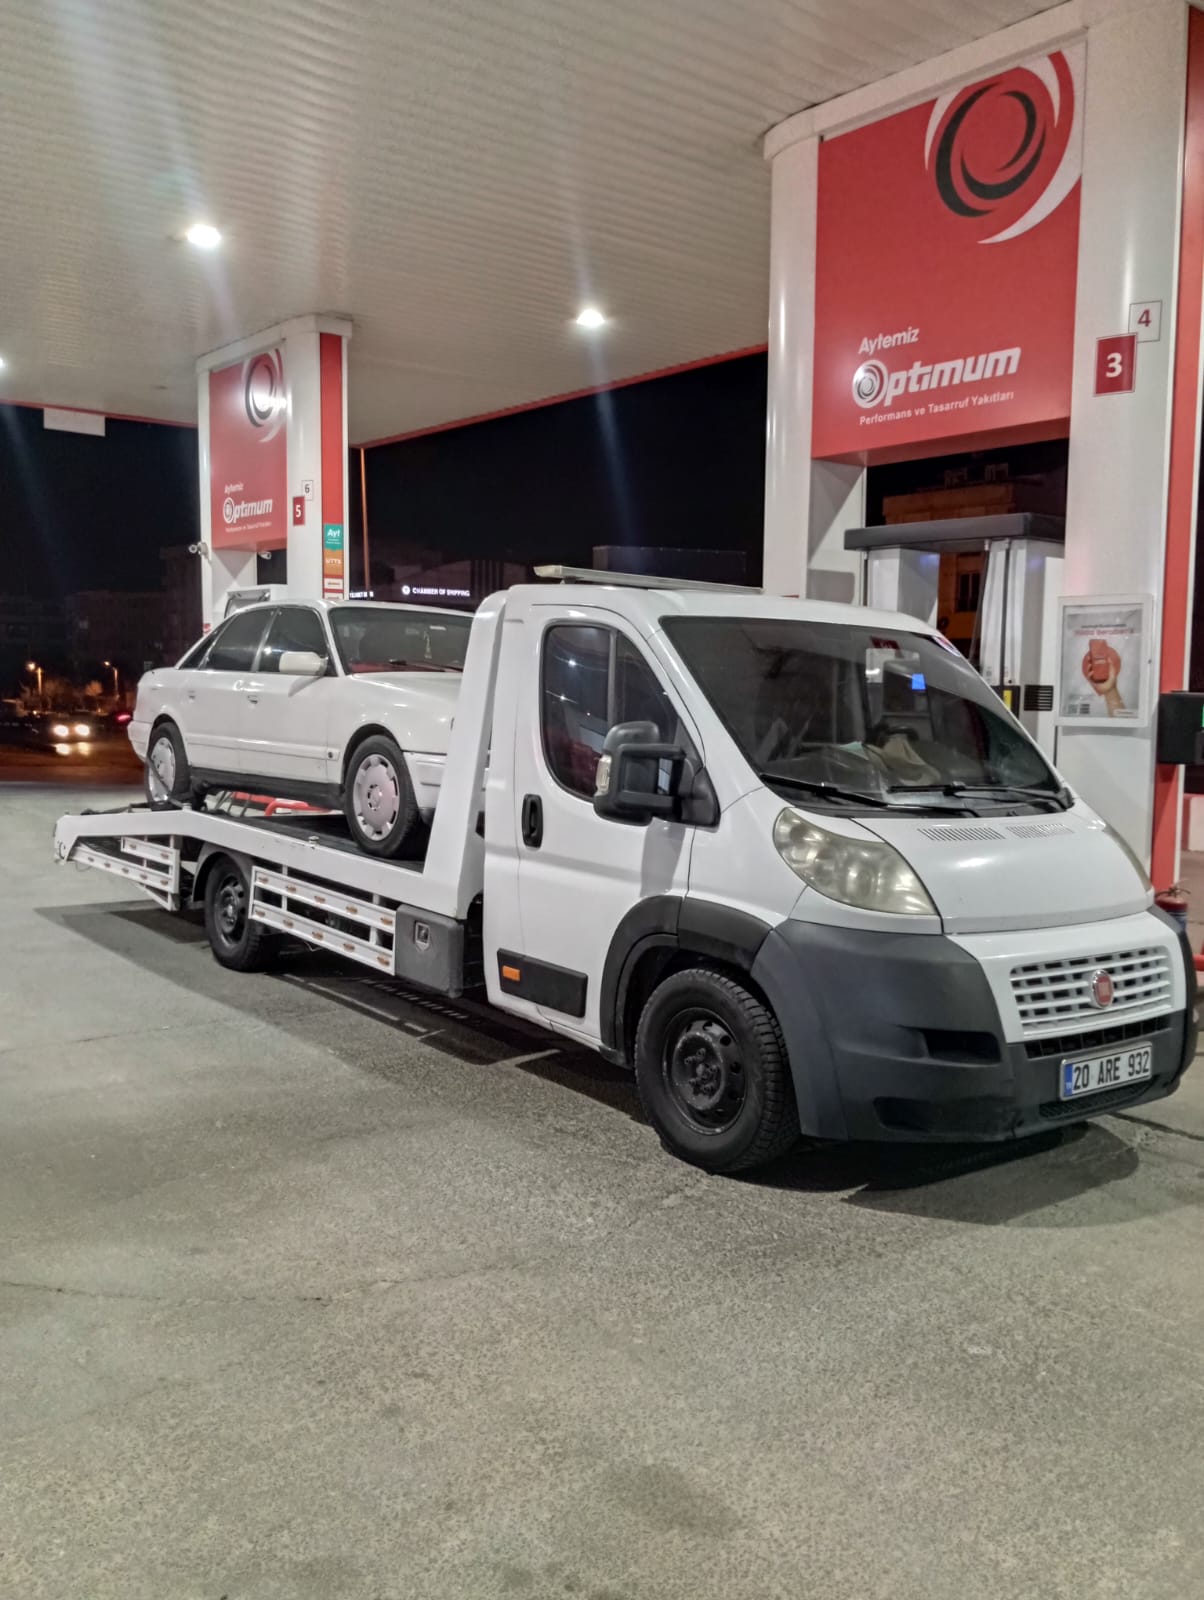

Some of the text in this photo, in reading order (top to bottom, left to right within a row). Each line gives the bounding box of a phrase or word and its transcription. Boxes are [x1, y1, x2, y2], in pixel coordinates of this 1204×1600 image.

[1137, 308, 1152, 328] 4
[858, 327, 920, 355] Aytemiz
[852, 346, 1021, 409] Optimum
[1105, 352, 1123, 378] 3
[859, 390, 1014, 426] Performans ve Tasarruf Yakıtları
[304, 484, 310, 494] 6
[295, 505, 302, 518] 5
[1073, 1050, 1150, 1090] 20 ARE 932
